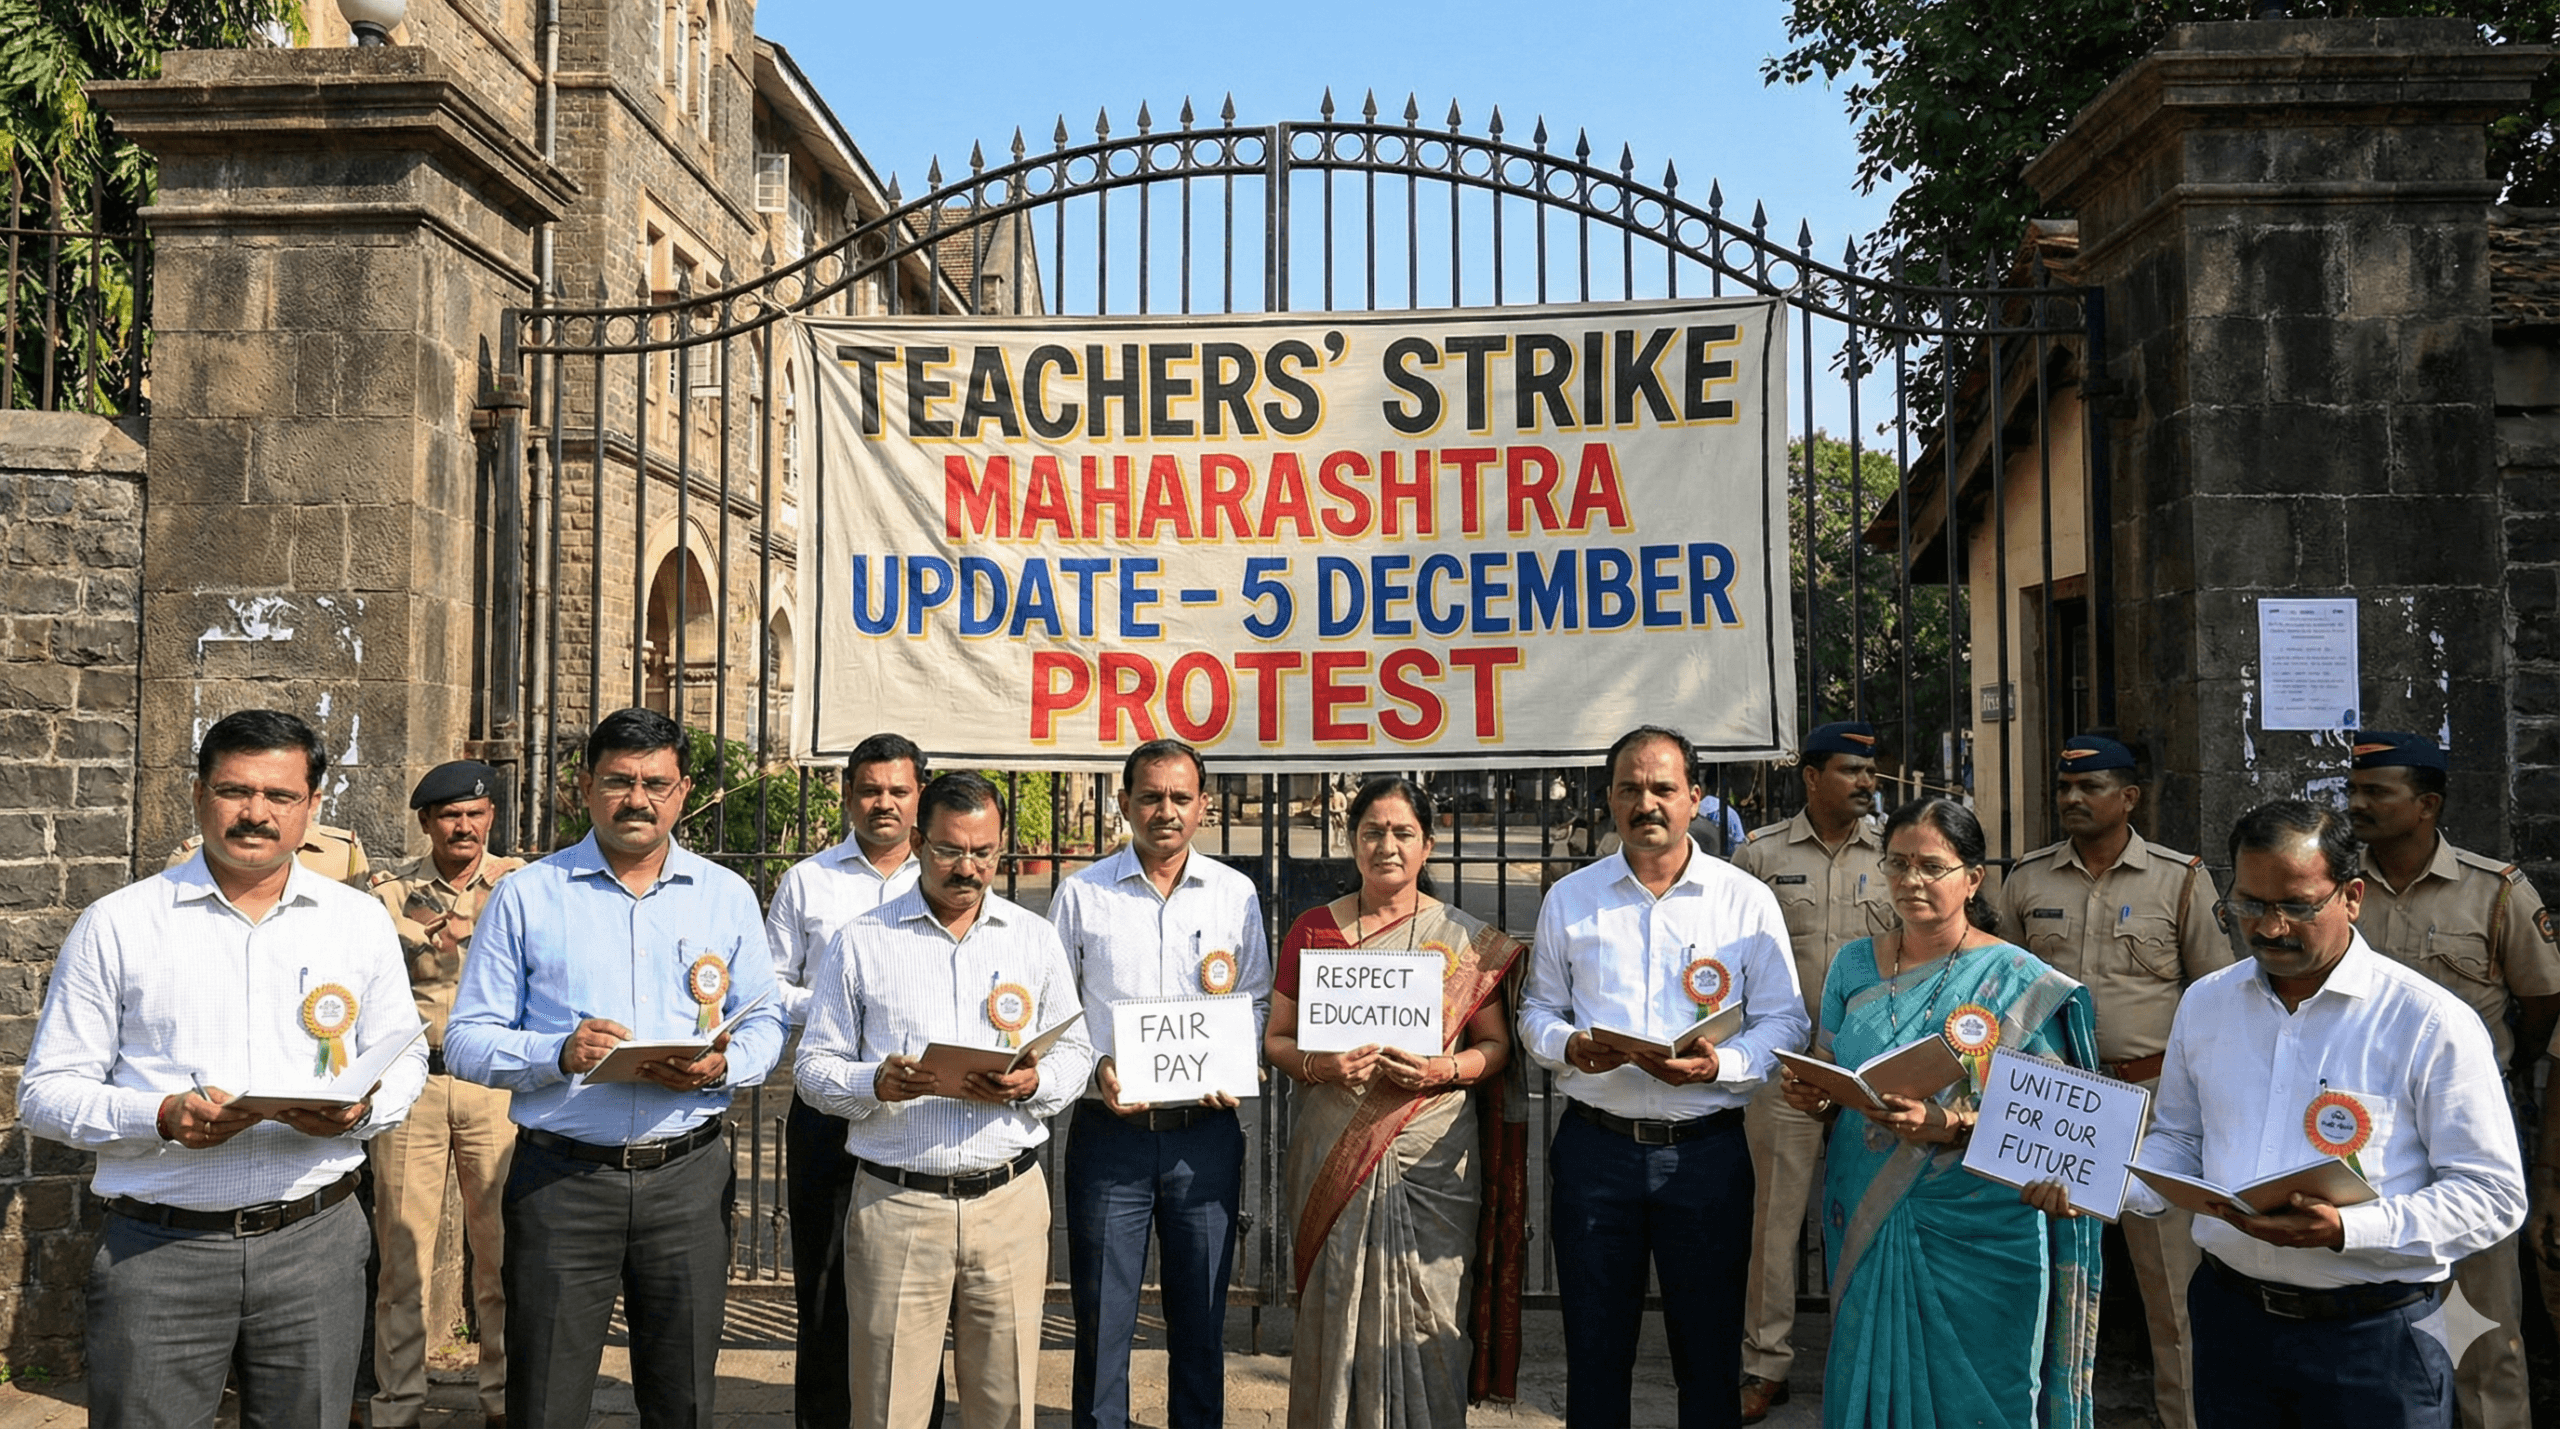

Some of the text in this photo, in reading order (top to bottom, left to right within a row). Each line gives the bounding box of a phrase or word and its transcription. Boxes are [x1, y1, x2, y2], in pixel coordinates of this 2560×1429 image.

[836, 324, 1738, 442] TEACHERS’ STRIKE
[945, 443, 1633, 542] MAHARASHTRA
[853, 554, 1162, 640] UPDATE
[1241, 556, 1294, 638] 5
[1318, 543, 1739, 638] DECEMBER
[1030, 646, 1521, 745] PROTEST
[1316, 965, 1414, 990] RESPECT
[1140, 1012, 1210, 1042] FAIR
[1309, 1003, 1430, 1028] EDUCATION
[1154, 1052, 1209, 1083] PAY
[2005, 1102, 2097, 1148] FOR OUR
[1998, 1133, 2096, 1185] FUTURE
